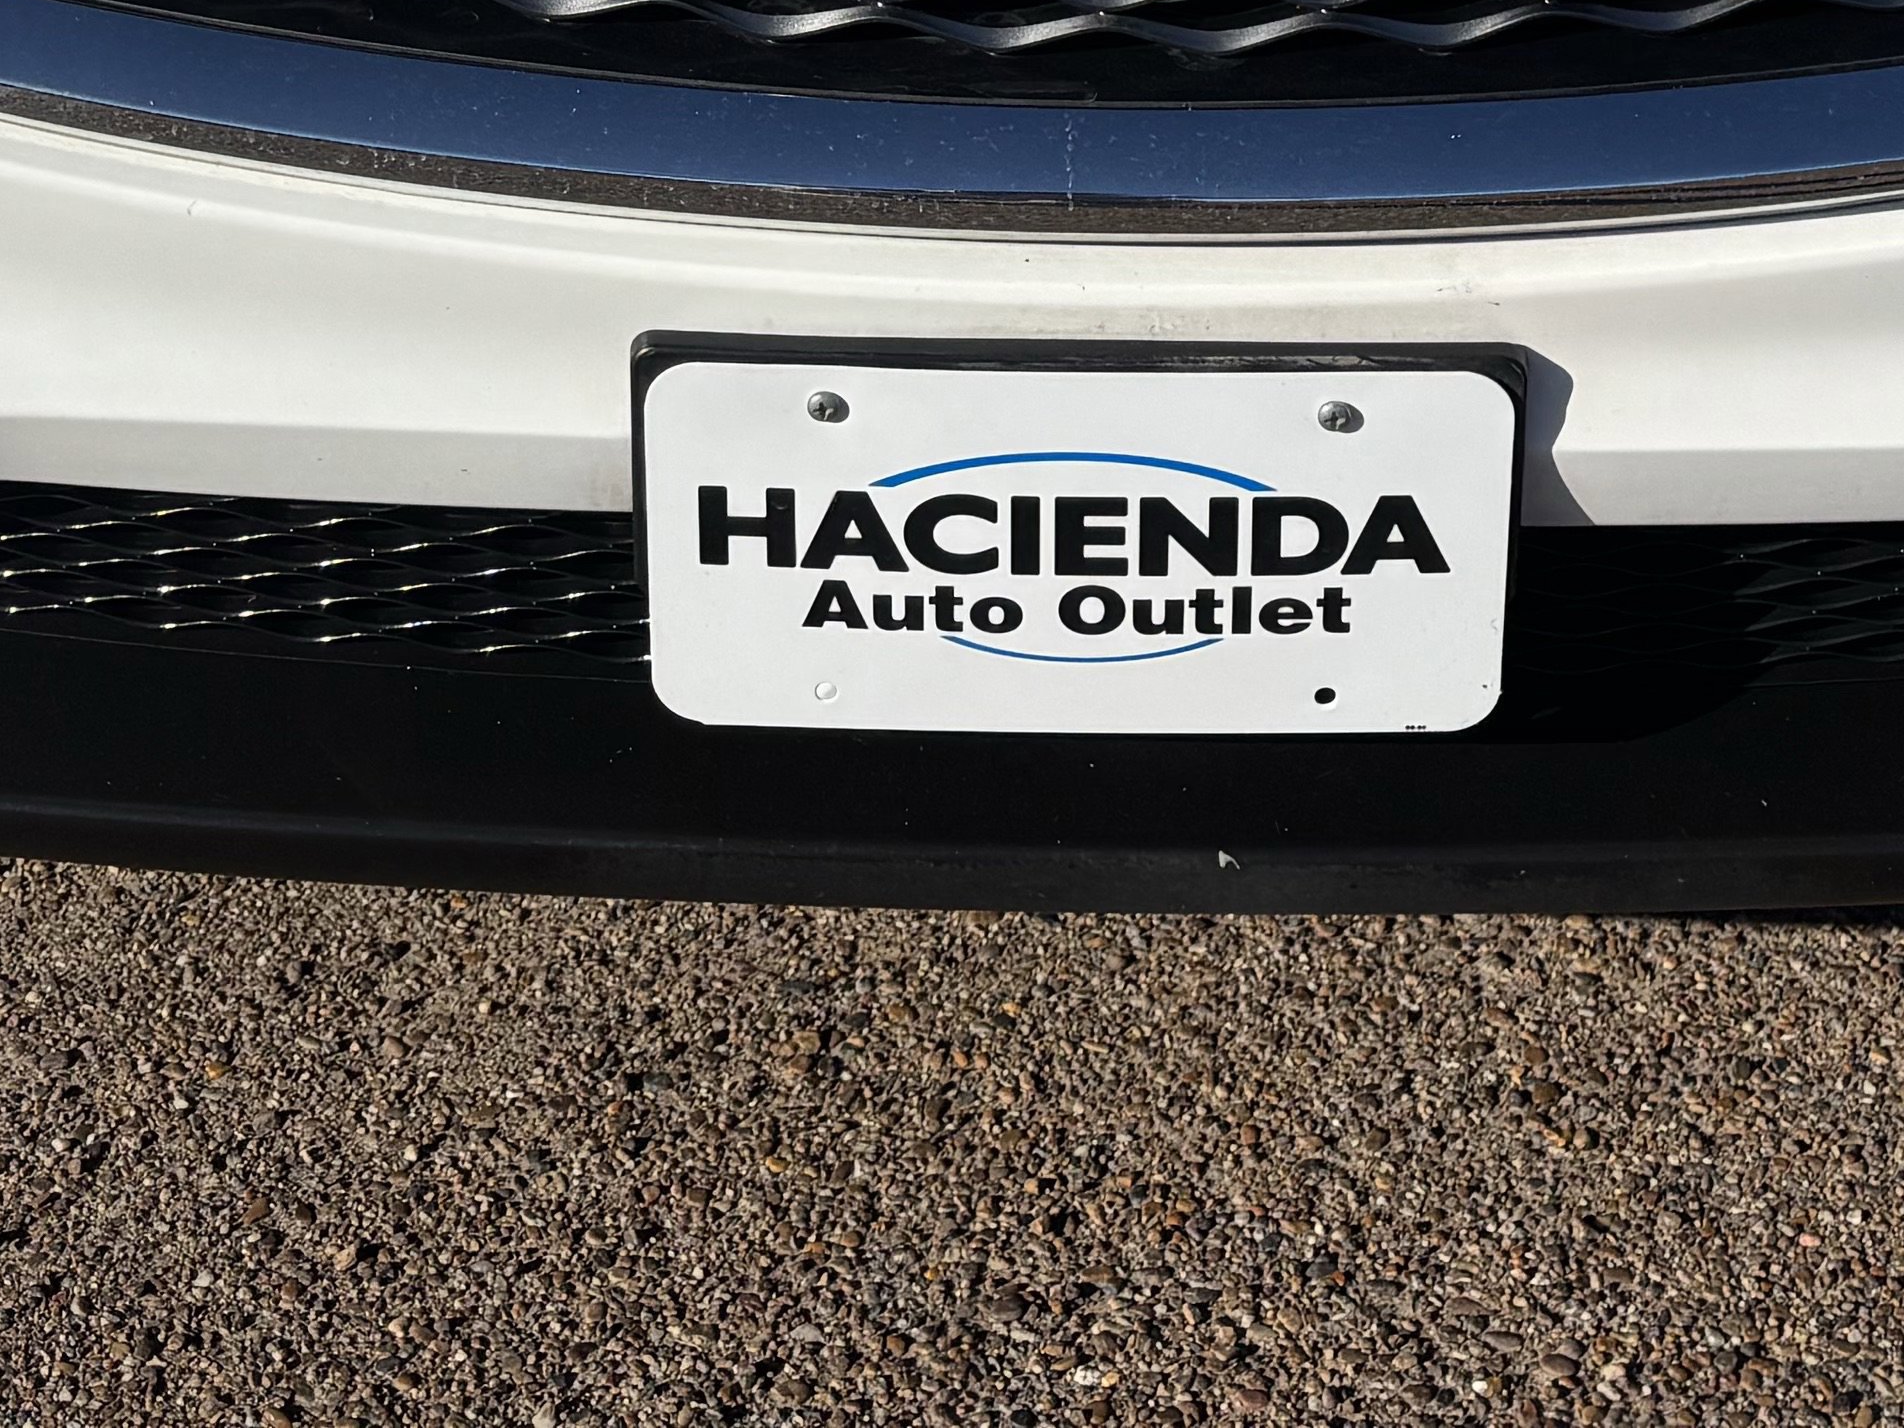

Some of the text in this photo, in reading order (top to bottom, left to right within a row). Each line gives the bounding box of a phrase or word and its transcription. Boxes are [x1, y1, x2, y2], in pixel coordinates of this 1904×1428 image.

[697, 485, 1452, 577] HACIENDA
[800, 579, 1353, 636] Auto Outlet
